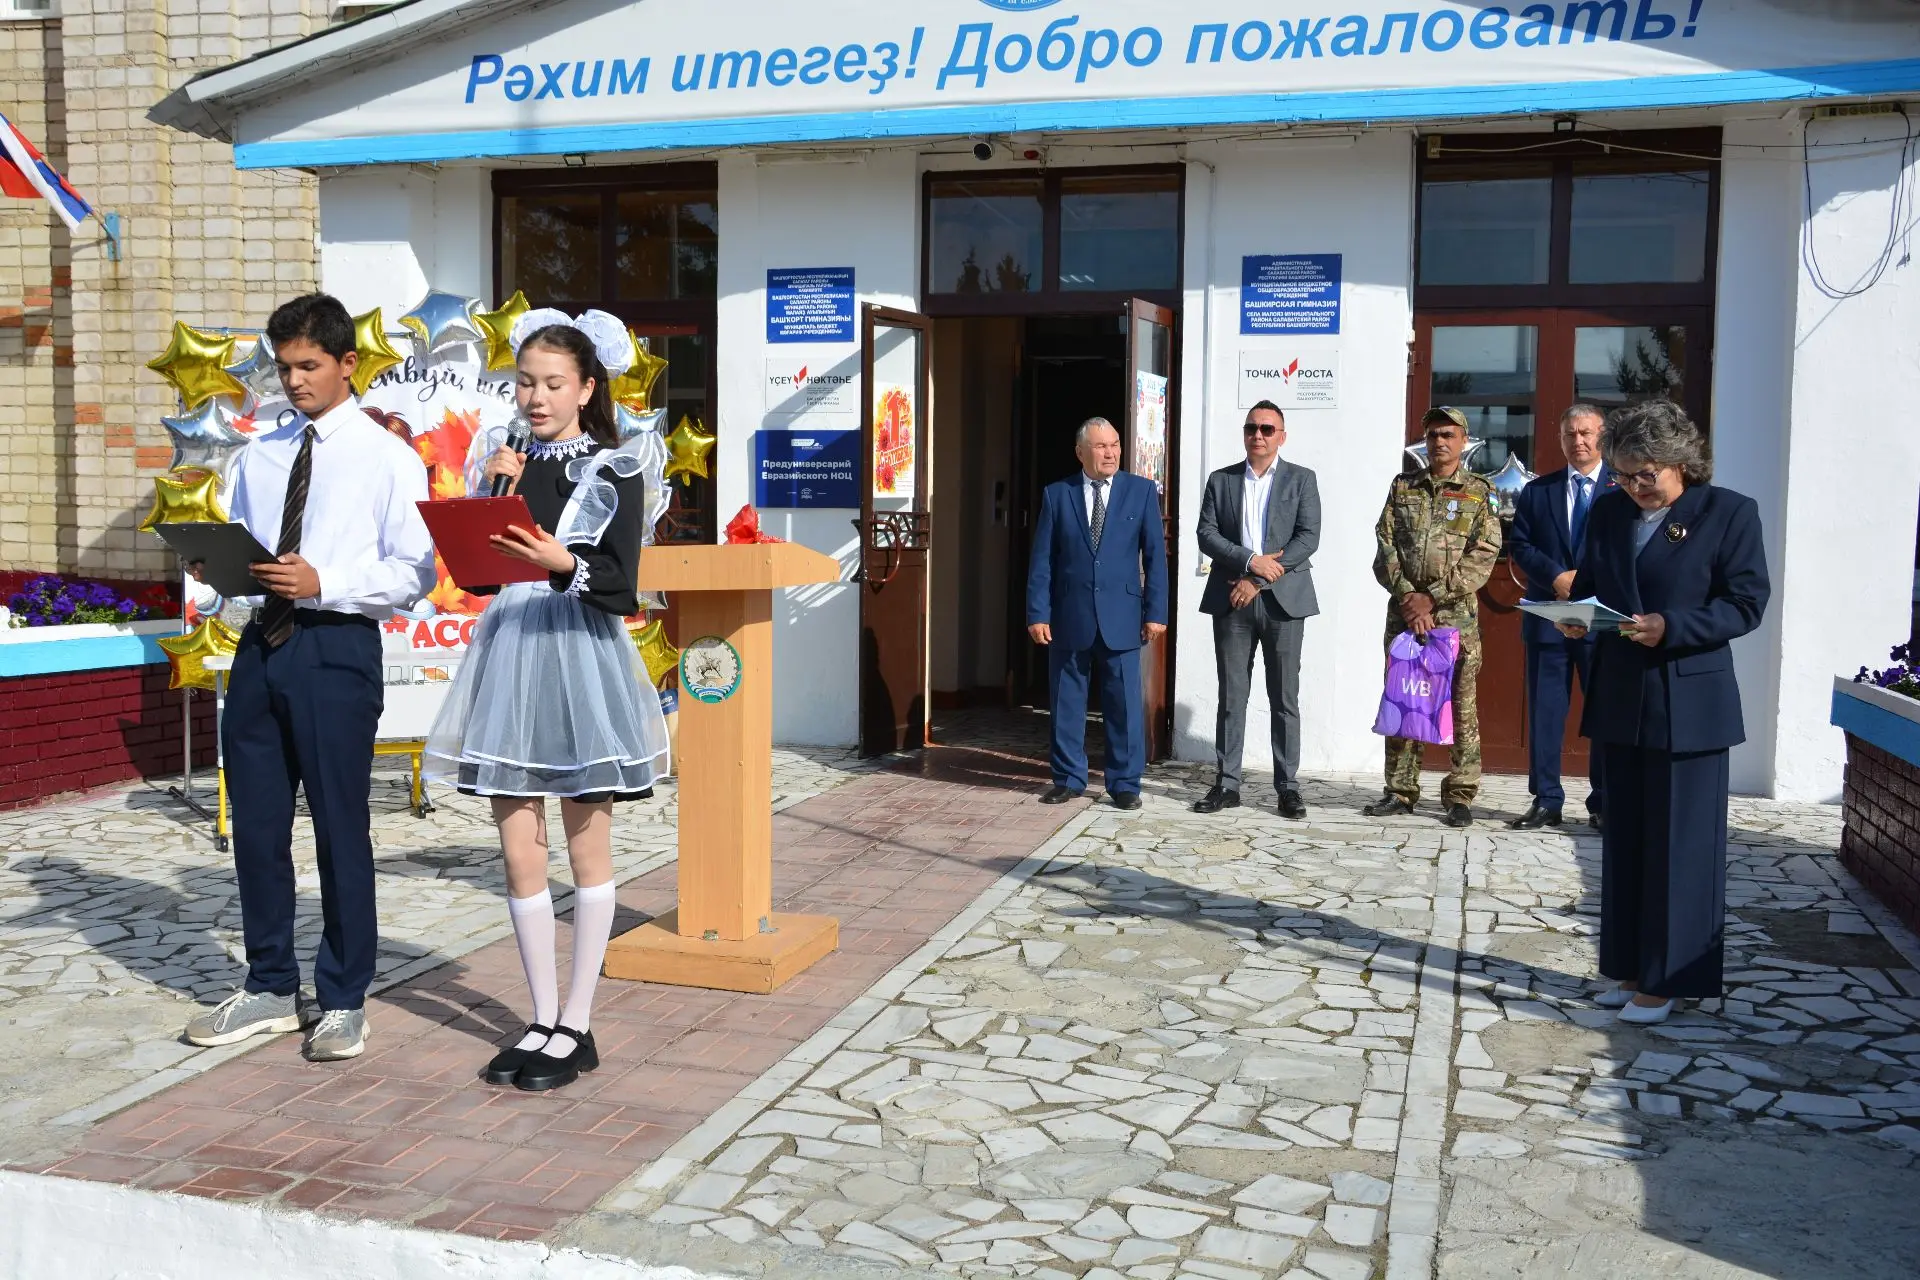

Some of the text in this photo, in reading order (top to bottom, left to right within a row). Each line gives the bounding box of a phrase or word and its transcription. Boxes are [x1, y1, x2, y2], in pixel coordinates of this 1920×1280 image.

[464, 0, 1701, 103] Рәхим итегеҙ! Добро пожаловать!
[1296, 300, 1338, 308] ГИМНАЗИЯ
[1245, 369, 1333, 378] ТОЧКА РОСТА
[762, 459, 852, 470] Предуниверсарий
[761, 471, 853, 481] Евразийского НОЦ
[1401, 677, 1431, 697] WB
